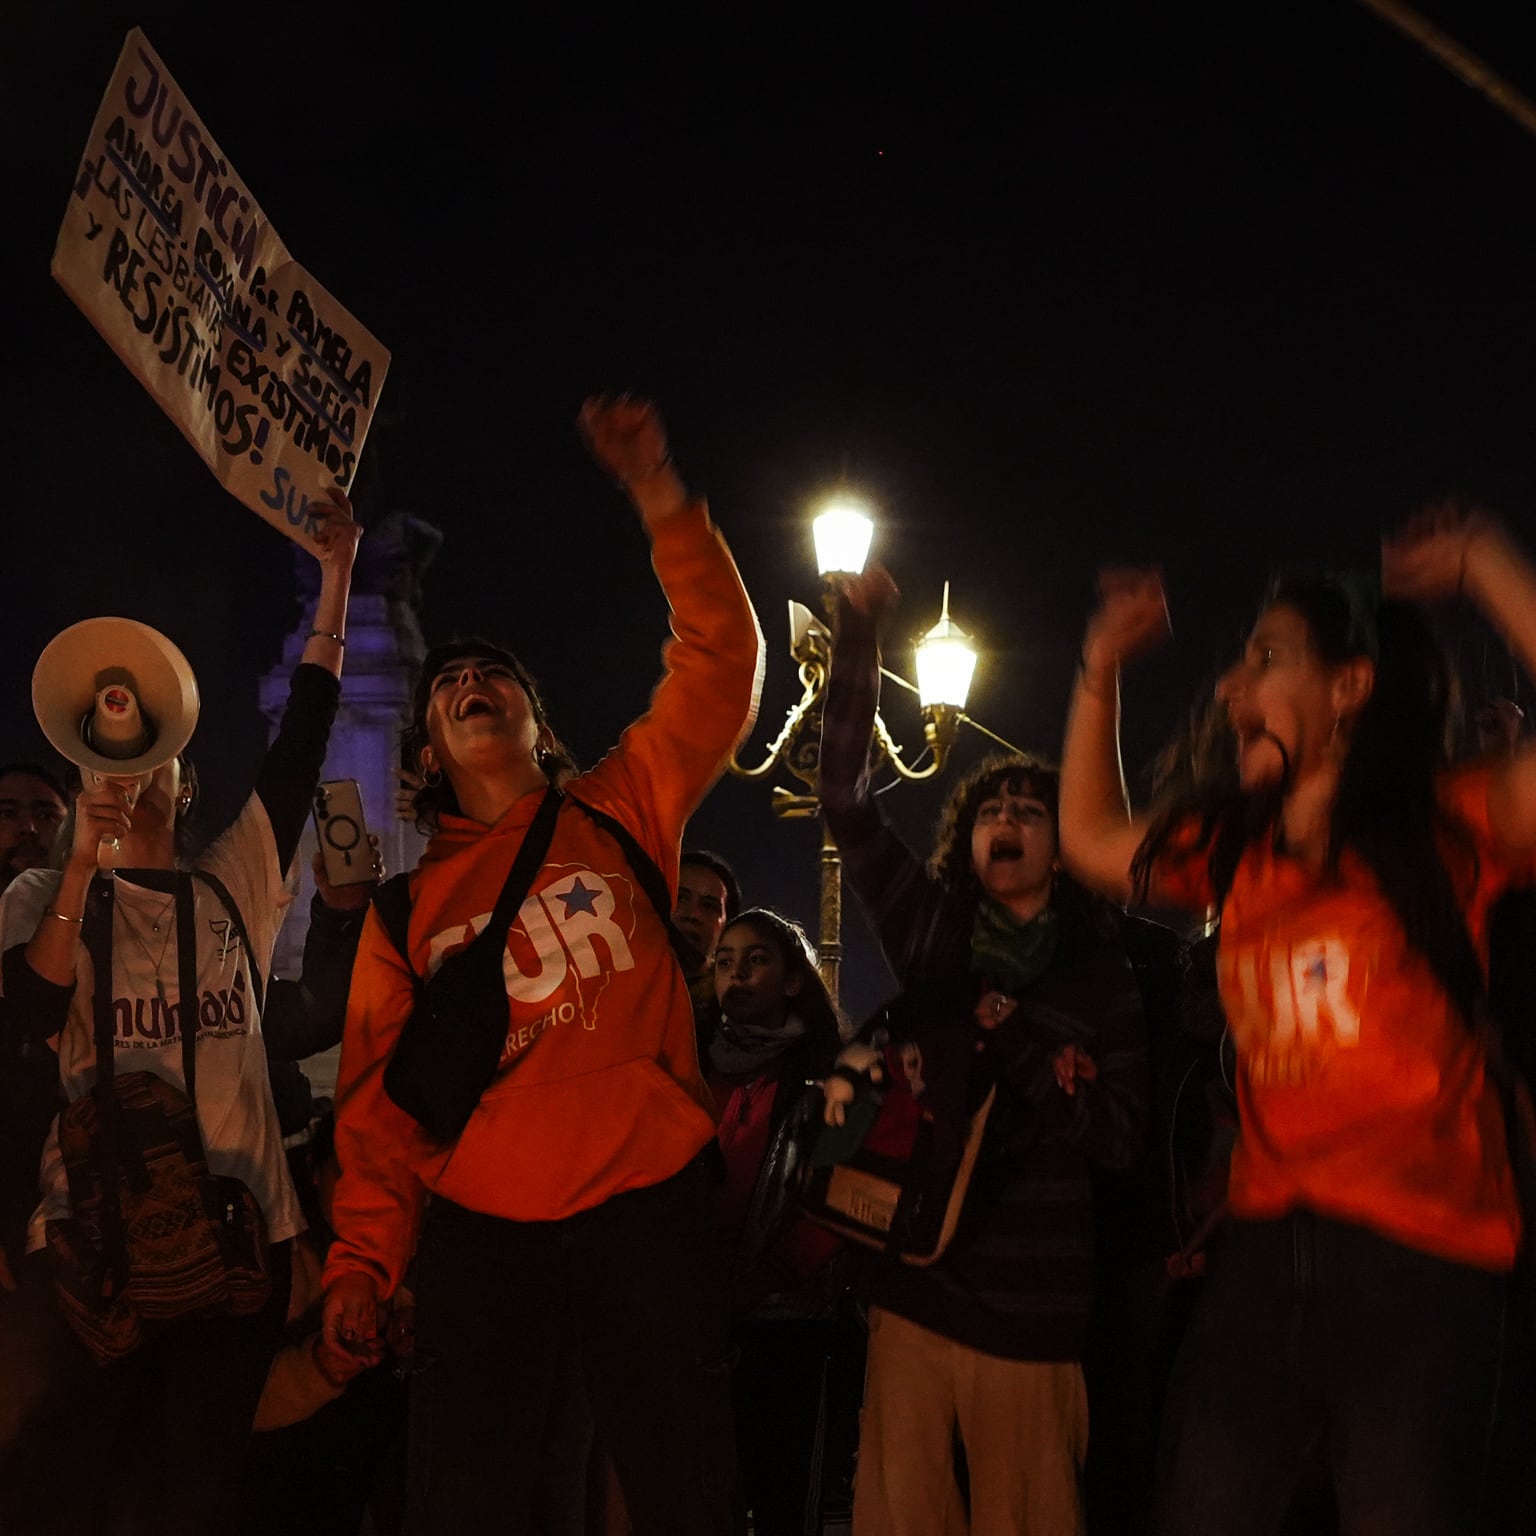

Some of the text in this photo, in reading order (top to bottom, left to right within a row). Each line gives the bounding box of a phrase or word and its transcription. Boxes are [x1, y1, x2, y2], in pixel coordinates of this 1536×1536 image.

[85, 211, 103, 241] Y
[125, 47, 372, 410] JUSTICIA POR PAMELA
[195, 227, 267, 348] ROXANA
[275, 331, 291, 358] Y
[227, 338, 356, 487] EXISTIMOS
